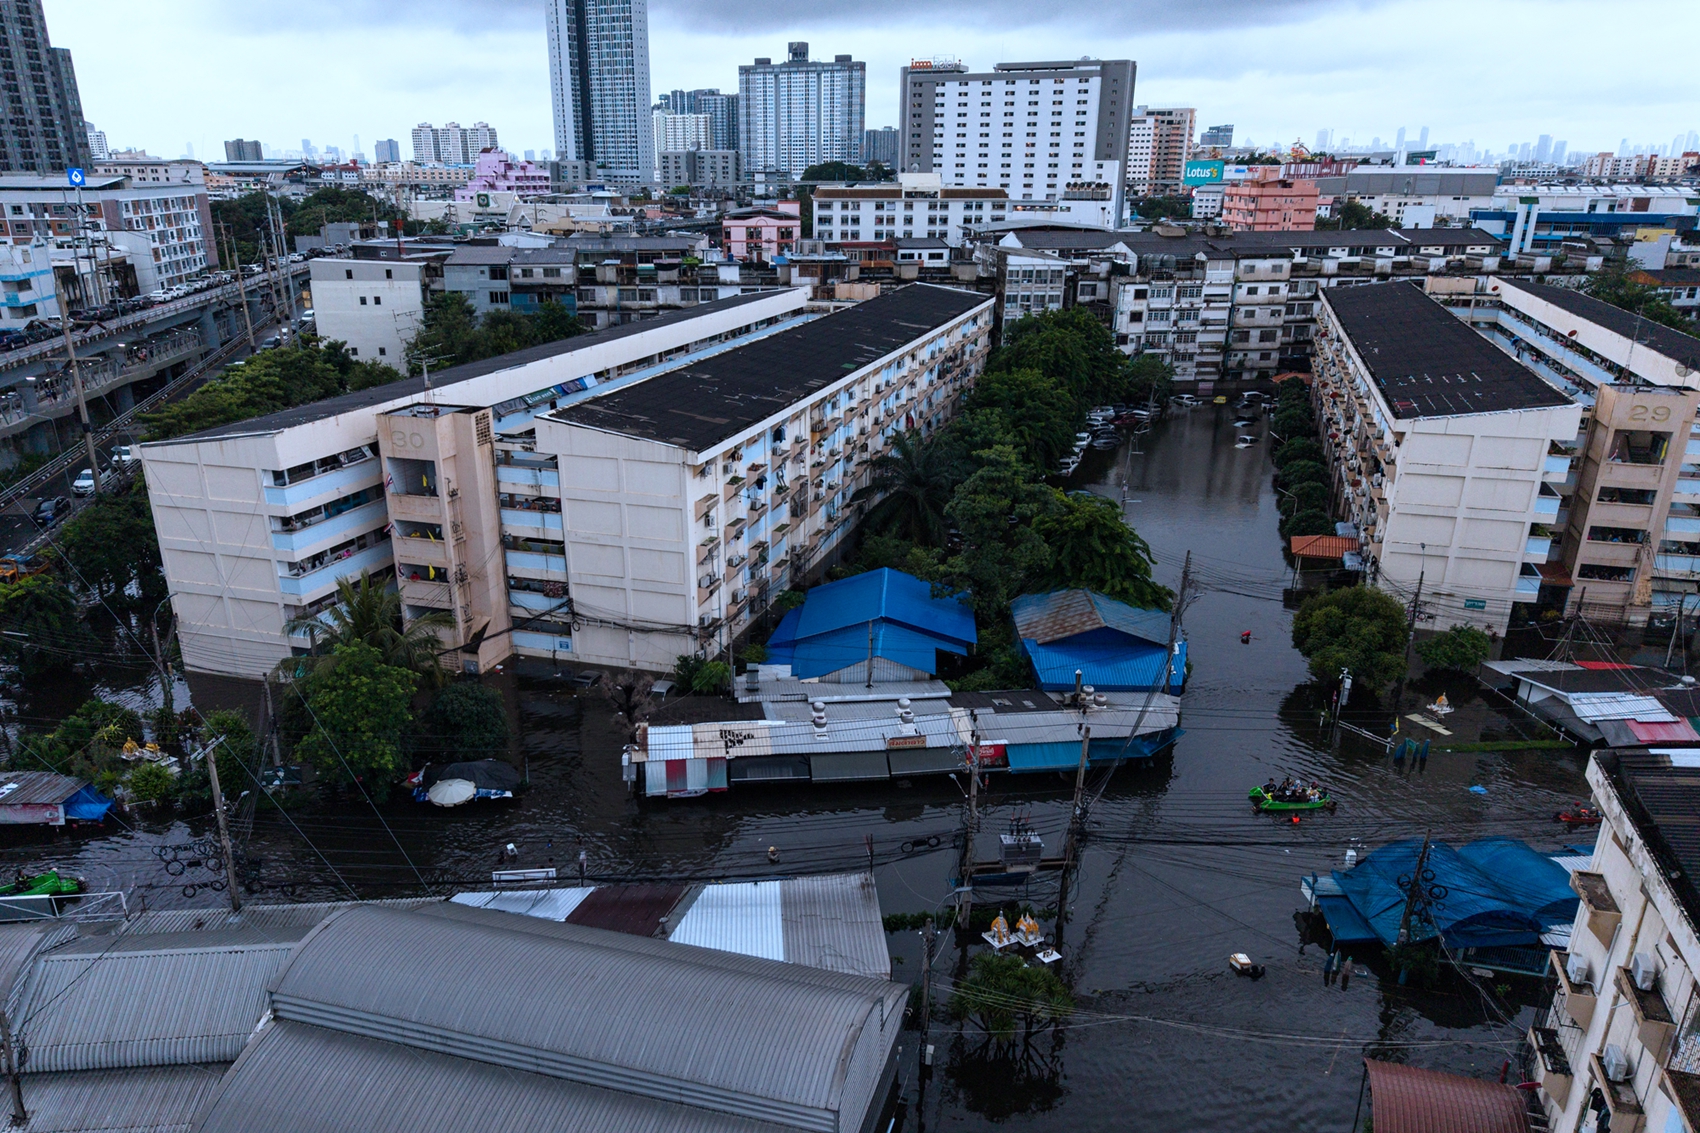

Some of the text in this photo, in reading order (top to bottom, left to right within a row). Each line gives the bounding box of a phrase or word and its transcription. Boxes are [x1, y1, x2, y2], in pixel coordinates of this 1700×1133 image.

[1186, 167, 1218, 178] Lotus's
[1627, 404, 1671, 422] 29
[391, 430, 425, 449] 30
